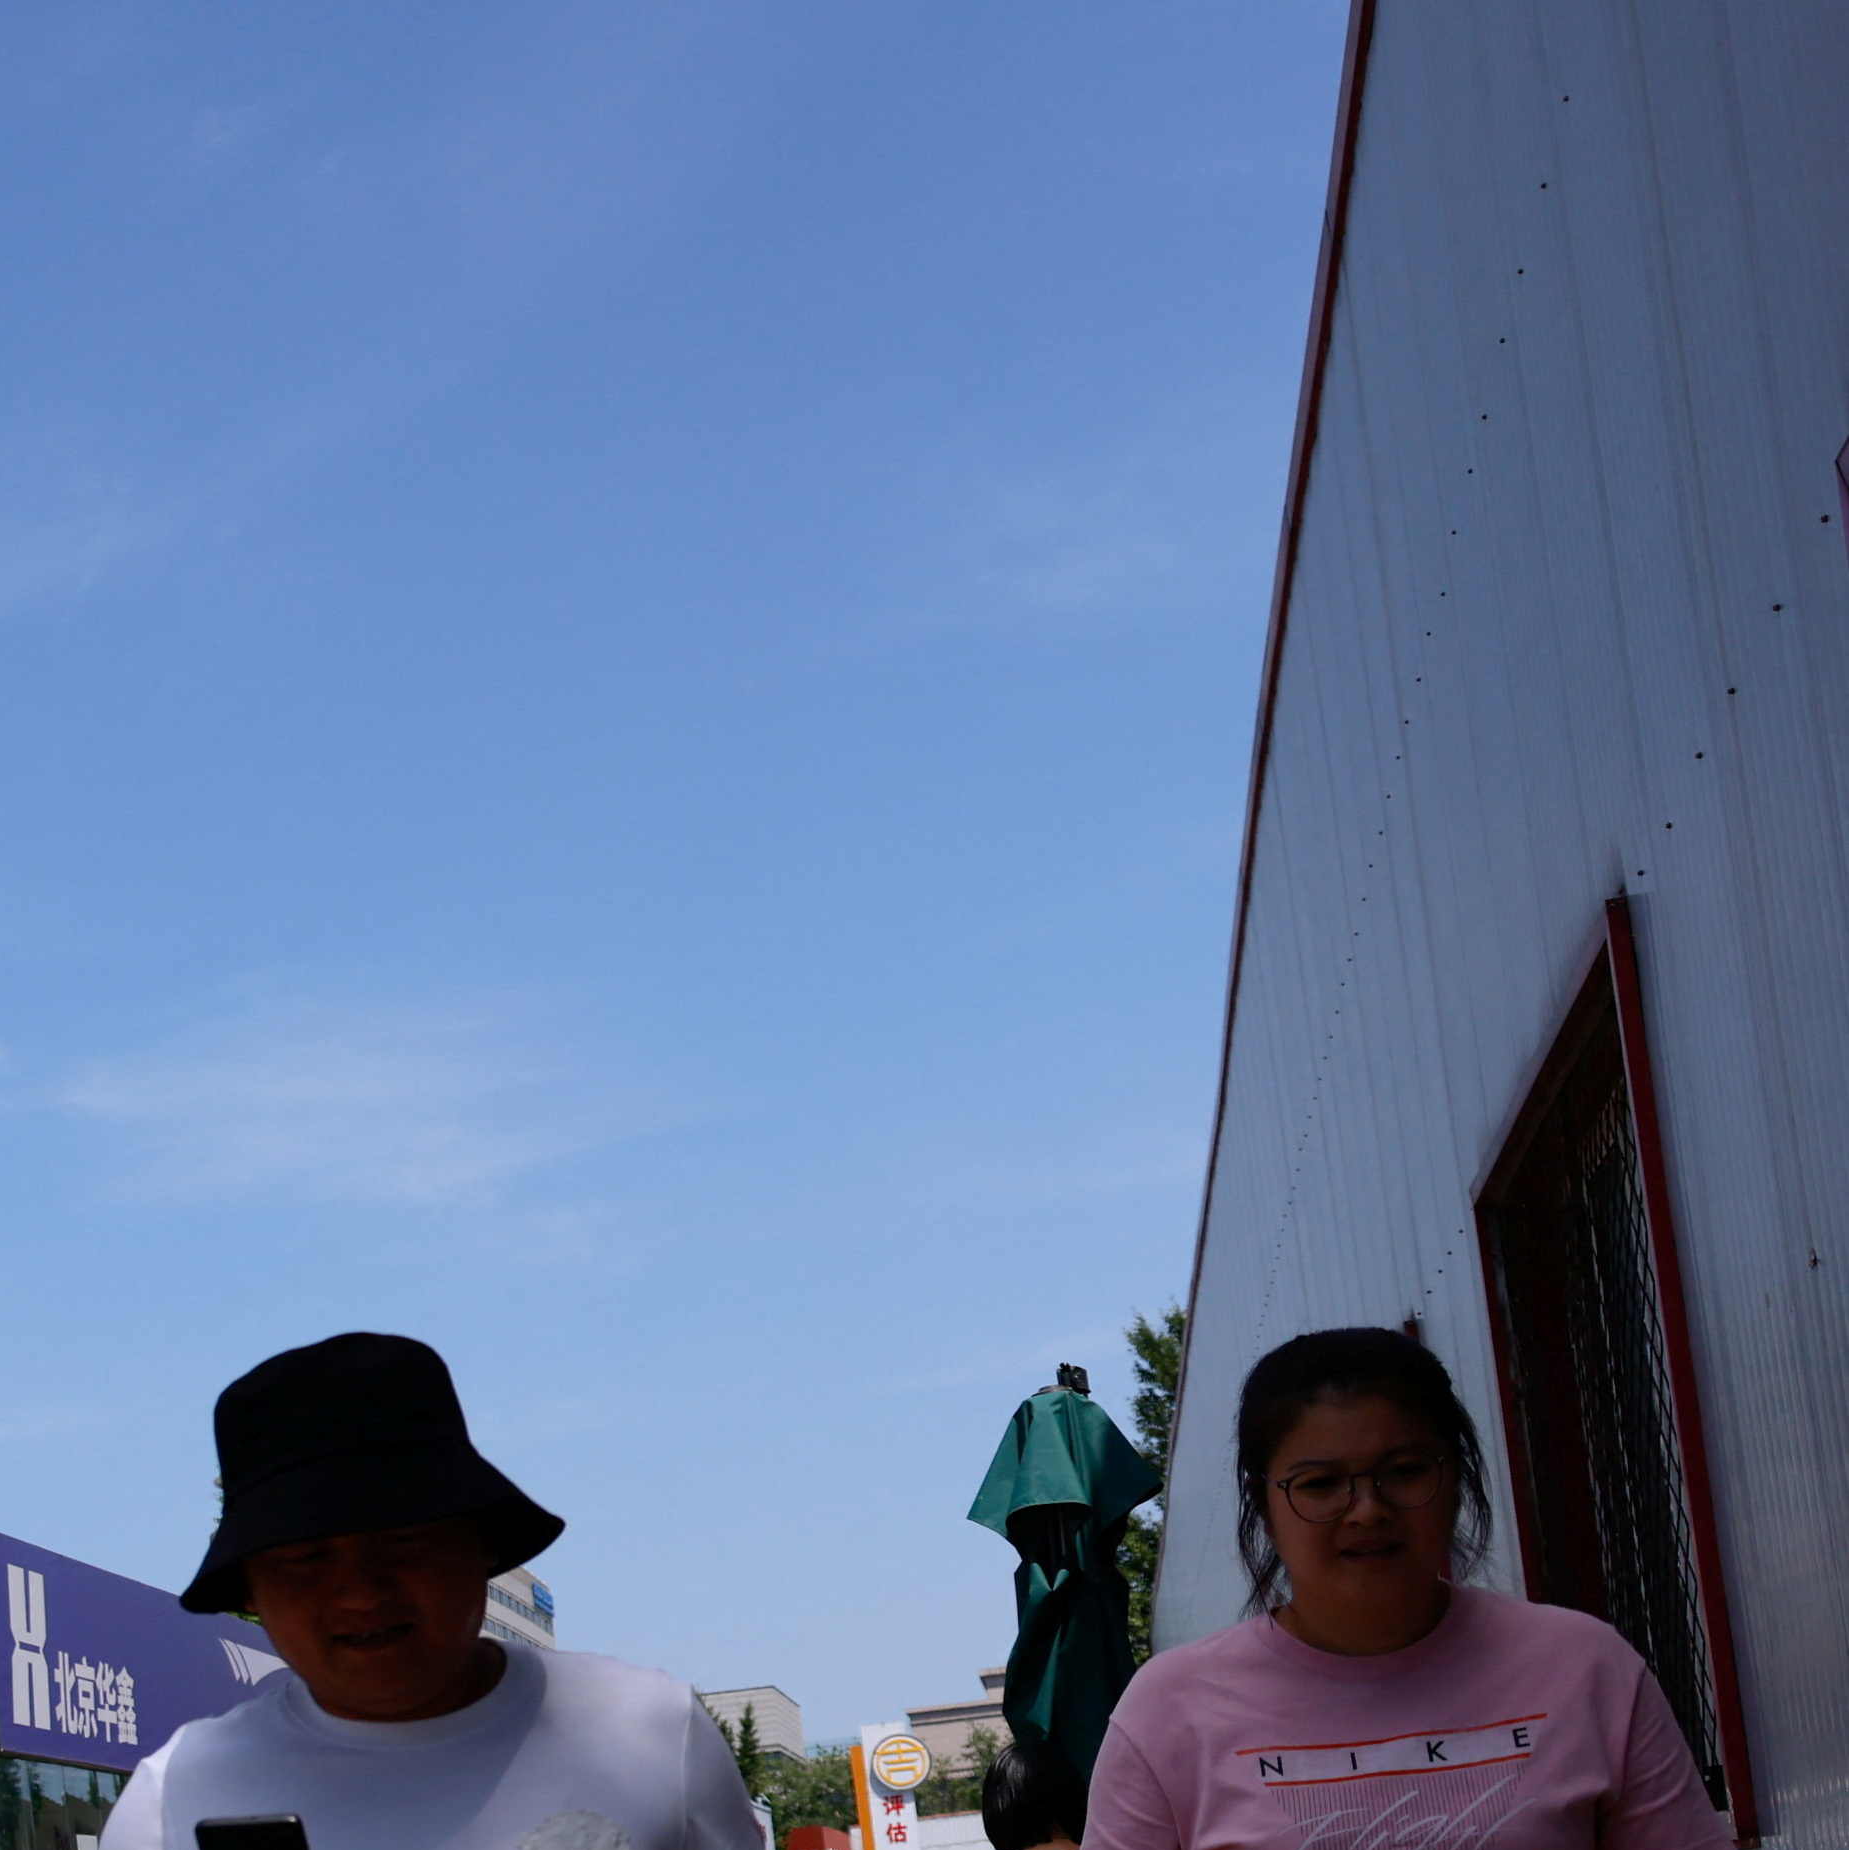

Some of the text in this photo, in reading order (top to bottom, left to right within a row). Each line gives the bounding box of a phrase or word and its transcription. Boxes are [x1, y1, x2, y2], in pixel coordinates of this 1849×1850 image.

[54, 1650, 139, 1746] 北京华鑫
[1258, 1725, 1532, 1779] NIKE
